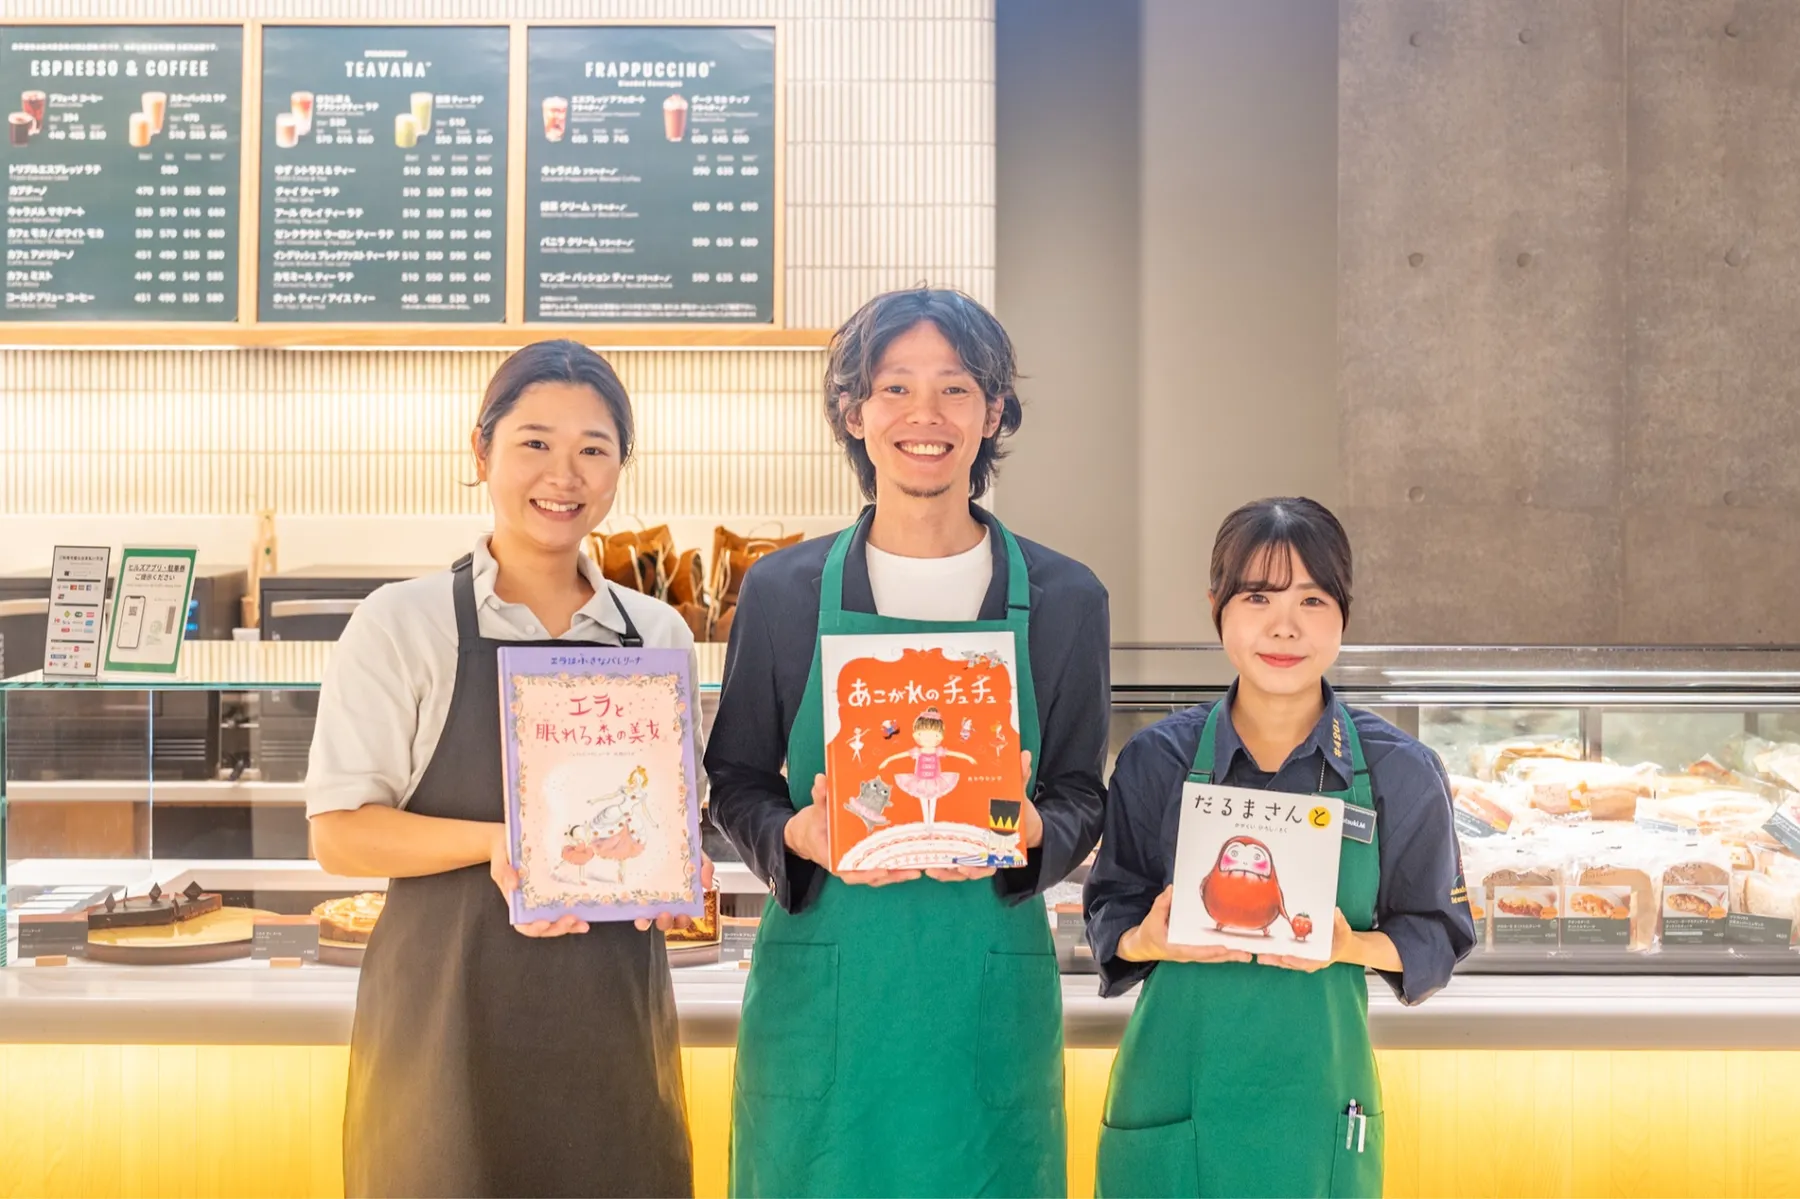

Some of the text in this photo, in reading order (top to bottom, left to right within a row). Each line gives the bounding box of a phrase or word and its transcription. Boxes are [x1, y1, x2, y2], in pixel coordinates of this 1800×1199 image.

[31, 59, 208, 76] ESPRESSO & COFFEE
[848, 675, 996, 707] あこがれのチュチュ
[569, 694, 624, 718] エラと
[536, 719, 660, 746] 眠れる森の美女
